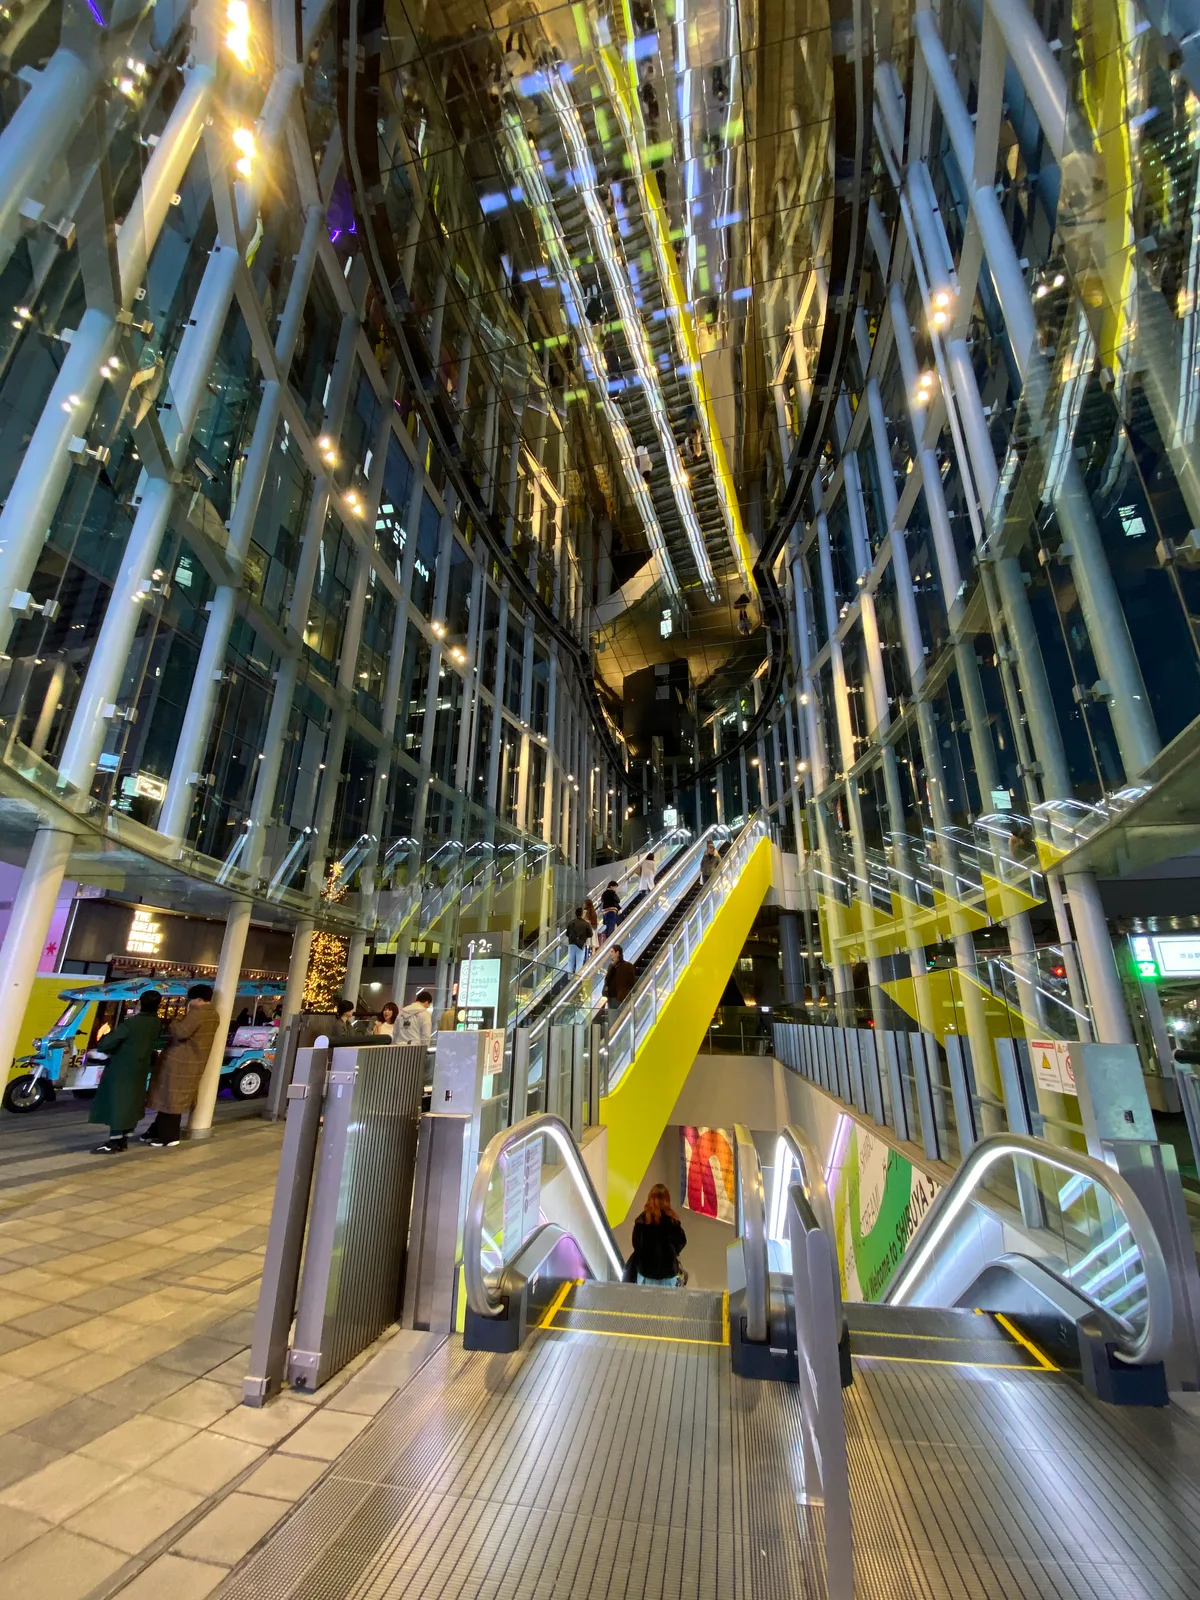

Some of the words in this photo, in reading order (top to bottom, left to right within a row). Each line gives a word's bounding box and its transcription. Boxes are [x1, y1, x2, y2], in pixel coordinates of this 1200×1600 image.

[868, 1253, 891, 1298] Welcome
[888, 1241, 898, 1265] to
[895, 1179, 929, 1253] SHIBUYA
